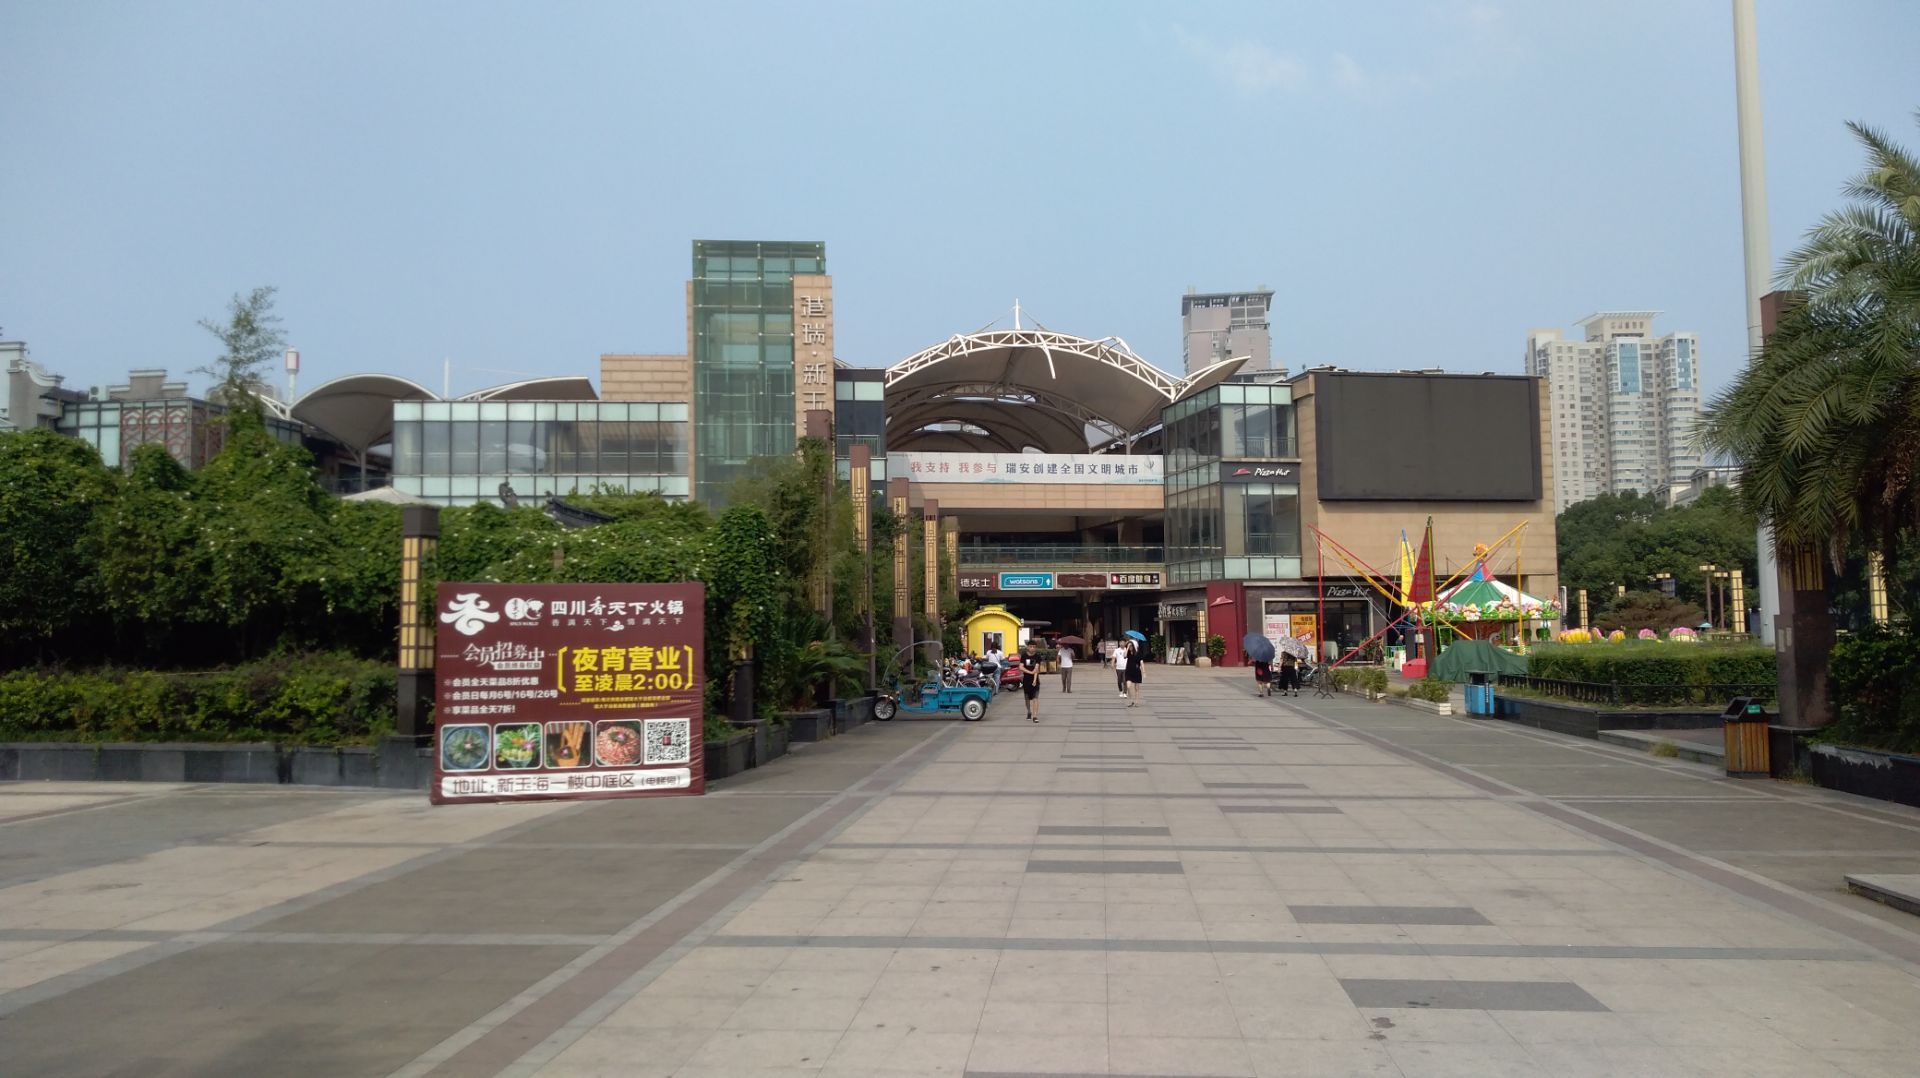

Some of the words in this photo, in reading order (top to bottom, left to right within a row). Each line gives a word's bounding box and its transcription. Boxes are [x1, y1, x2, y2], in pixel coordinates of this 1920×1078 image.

[800, 296, 827, 430] 港瑞·新玉
[911, 461, 950, 473] 我支持
[959, 462, 997, 473] 我参与
[1006, 462, 1139, 475] 瑞安创建全国文明城市
[1254, 467, 1275, 477] Pizza
[1275, 467, 1291, 476] Hut
[960, 578, 990, 588] 德克士
[1009, 578, 1039, 586] watsons
[1327, 586, 1352, 597] Pizza
[1353, 586, 1371, 597] Hut
[551, 596, 684, 616] 四川香天下火锅
[463, 640, 545, 667] 会员招募中
[572, 645, 681, 672] 夜宵营业
[574, 672, 682, 692] 至凌晨2:00
